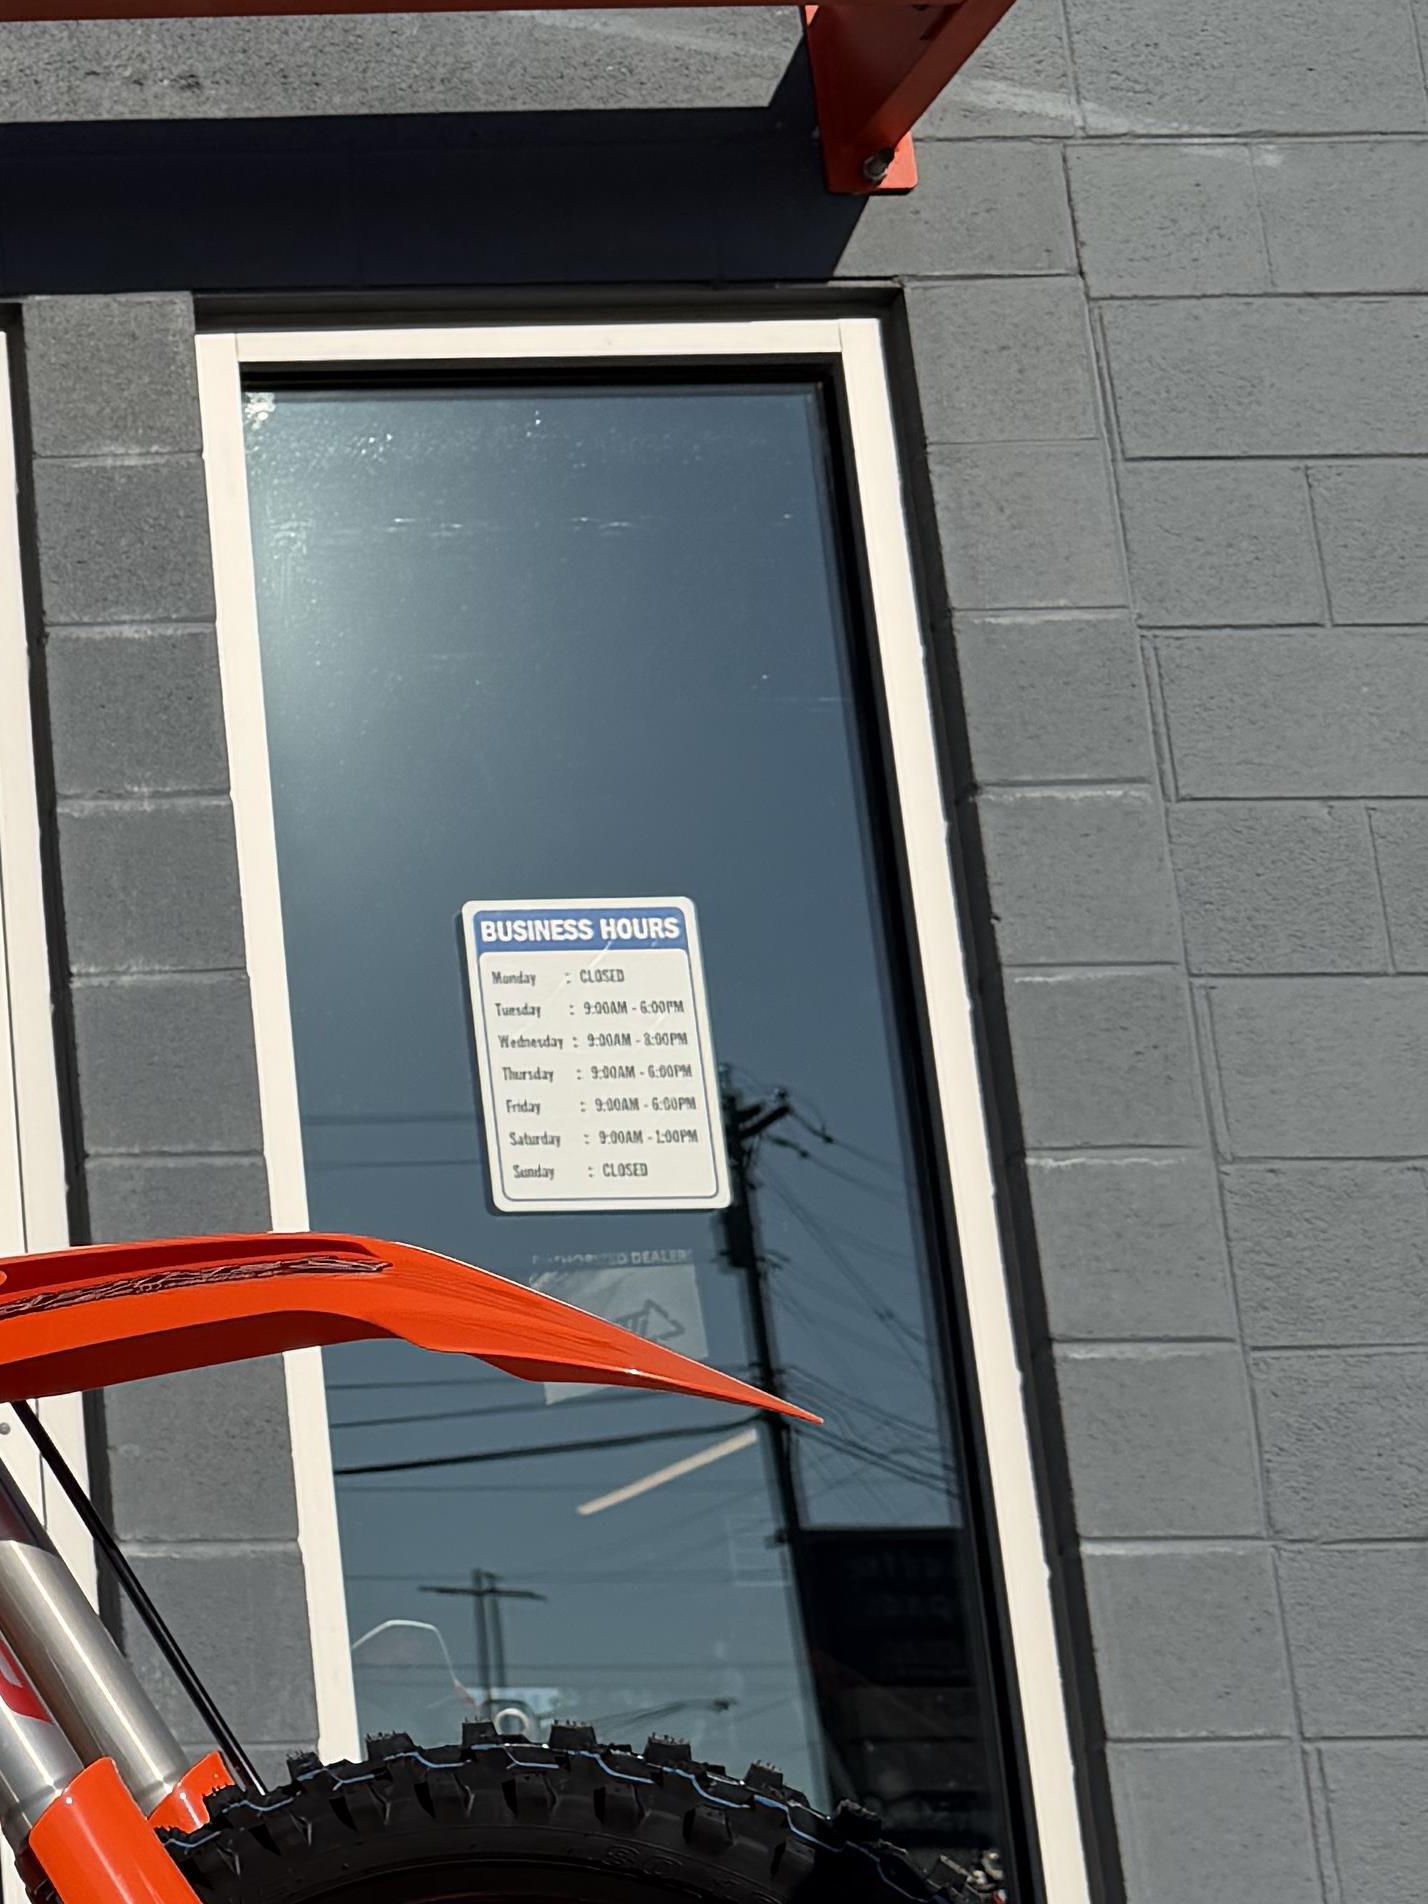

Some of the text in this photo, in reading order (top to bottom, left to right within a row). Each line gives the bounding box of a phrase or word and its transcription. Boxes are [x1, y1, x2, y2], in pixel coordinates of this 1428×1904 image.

[480, 916, 681, 943] BUSINESS HOURS
[491, 970, 537, 987] Monday
[579, 968, 625, 983] CLOSED
[494, 1002, 542, 1019] Tuesday
[583, 1001, 628, 1015] 9:00AM
[498, 1034, 564, 1050] Wednesday
[587, 1033, 632, 1047] 9:00AM
[501, 1066, 555, 1083] Thursday
[590, 1065, 636, 1080] 9:00AM
[505, 1099, 542, 1115] Friday
[594, 1097, 640, 1112] 9:00AM
[509, 1131, 562, 1148] Saturday
[598, 1130, 644, 1144] 9:00AM
[512, 1164, 555, 1180] Sunday
[602, 1162, 648, 1177] CLOSED
[631, 1249, 688, 1264] DEALER
